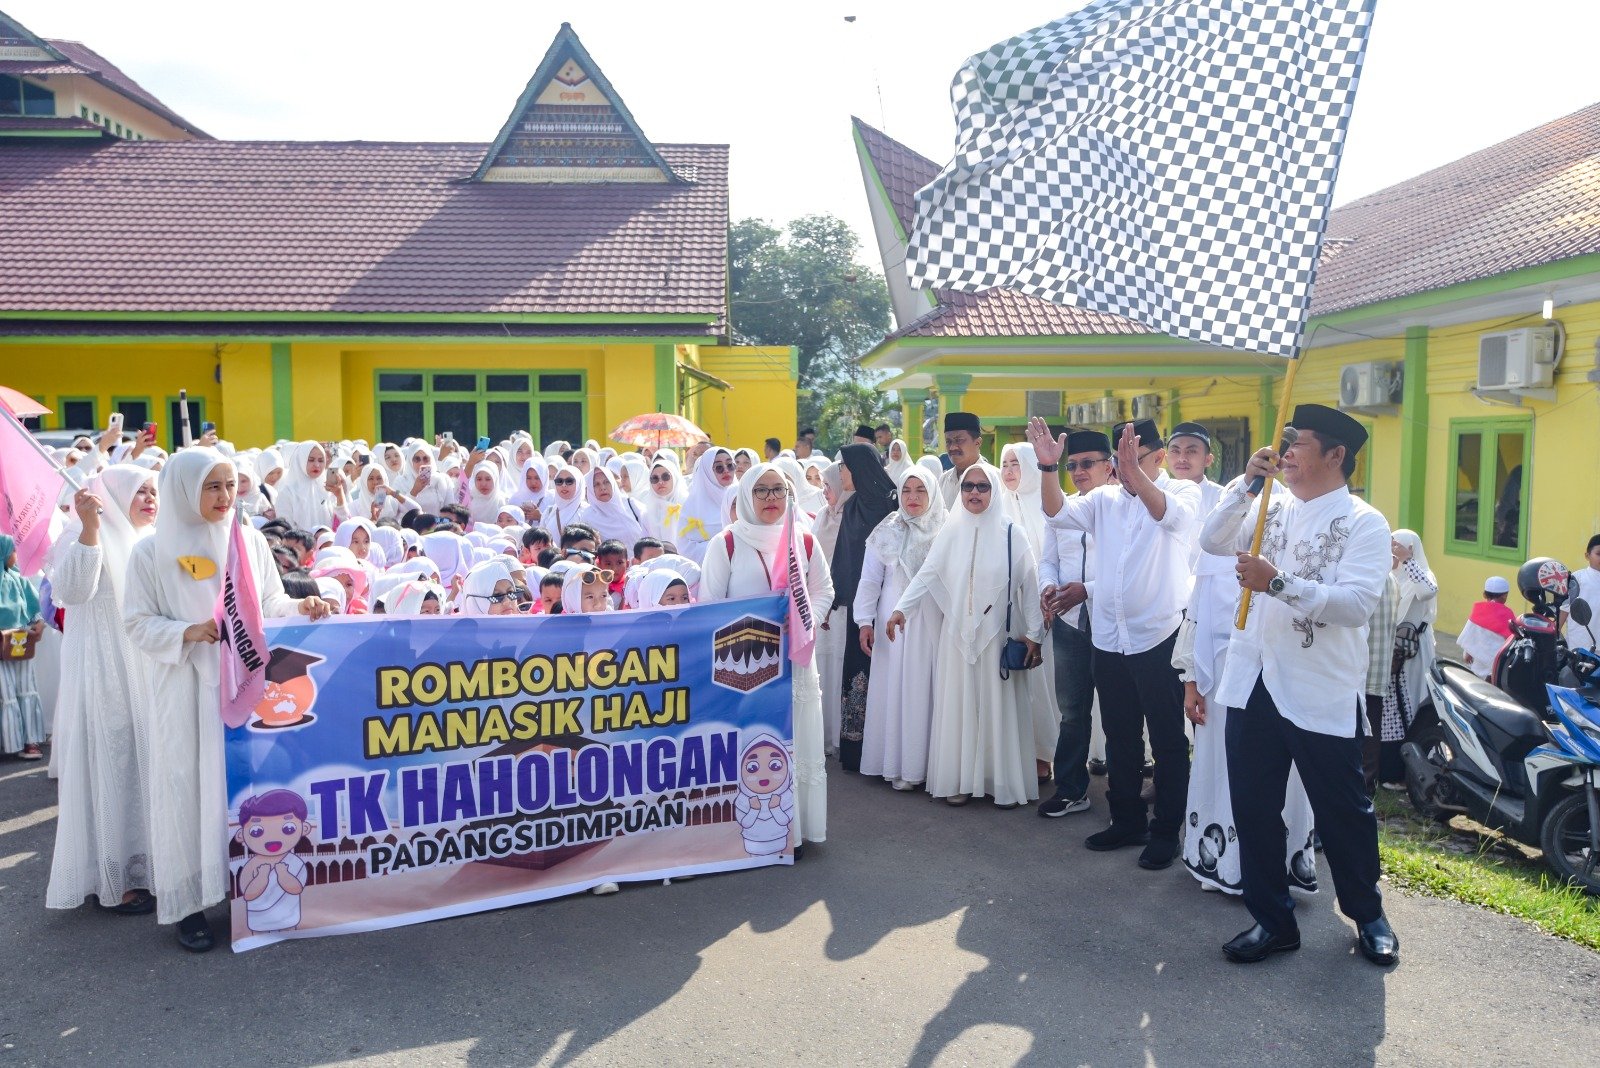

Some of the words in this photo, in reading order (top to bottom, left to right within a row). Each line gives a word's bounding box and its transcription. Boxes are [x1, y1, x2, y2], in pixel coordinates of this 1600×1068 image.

[224, 571, 264, 672] AHOLONGAN
[377, 645, 679, 707] ROMBONGAN
[364, 697, 584, 758] MANASIK
[591, 687, 690, 733] HAJI
[311, 774, 388, 840] TK
[402, 731, 739, 828] HAHOLONGAN
[371, 801, 686, 874] PADANGSIDIMPUAN
